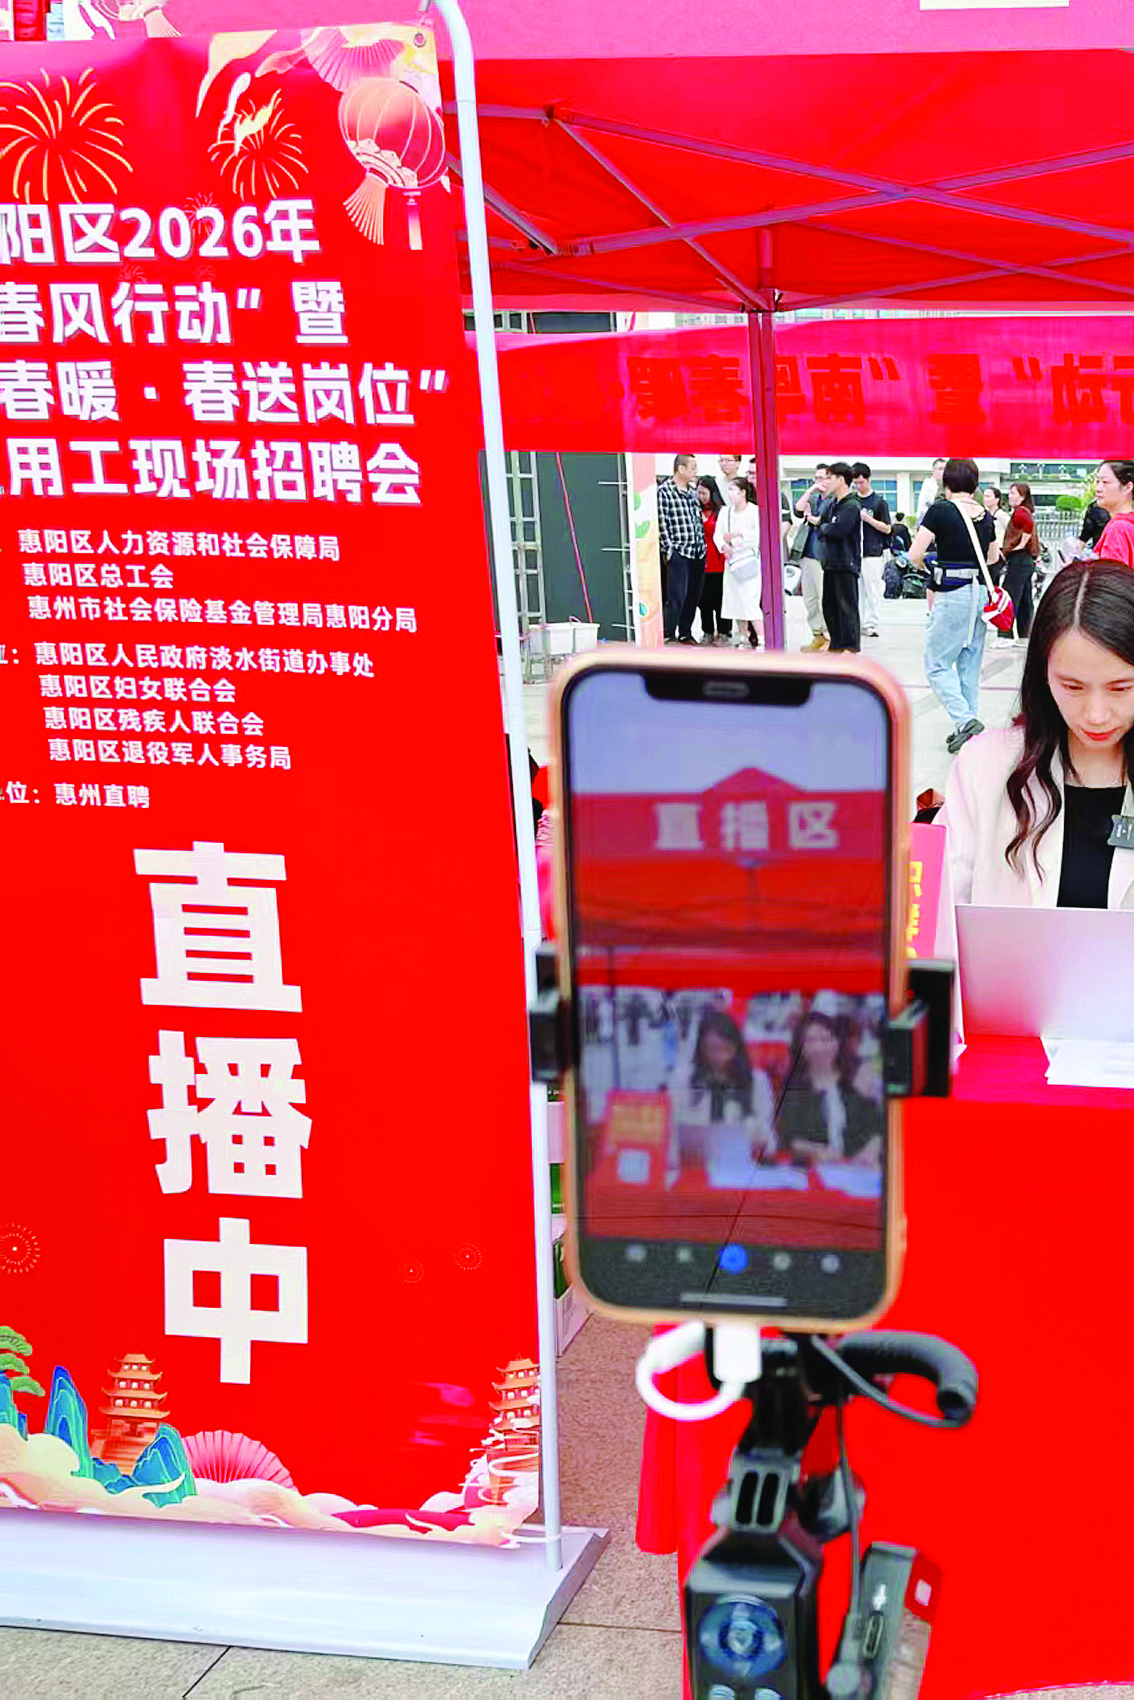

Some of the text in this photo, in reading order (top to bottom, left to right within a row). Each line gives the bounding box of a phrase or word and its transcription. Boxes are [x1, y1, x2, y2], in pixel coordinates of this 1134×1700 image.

[0, 199, 321, 265] 阳区2026年
[291, 280, 350, 344] 暨
[0, 437, 423, 505] 用工现场招聘会
[18, 528, 340, 561] 惠阳区人力资源和社会保障局
[22, 561, 175, 589] 惠阳区总工会
[27, 594, 418, 633] 惠州市社会保险基金管理局惠阳分局
[39, 673, 237, 703] 惠阳区妇女联合会
[43, 705, 265, 737] 惠阳区残疾人联合会
[47, 737, 292, 771] 惠阳区退役军人事务局
[0, 780, 151, 809] 位：惠州直聘
[653, 801, 841, 852] 直播区
[133, 841, 312, 1385] 直播中
